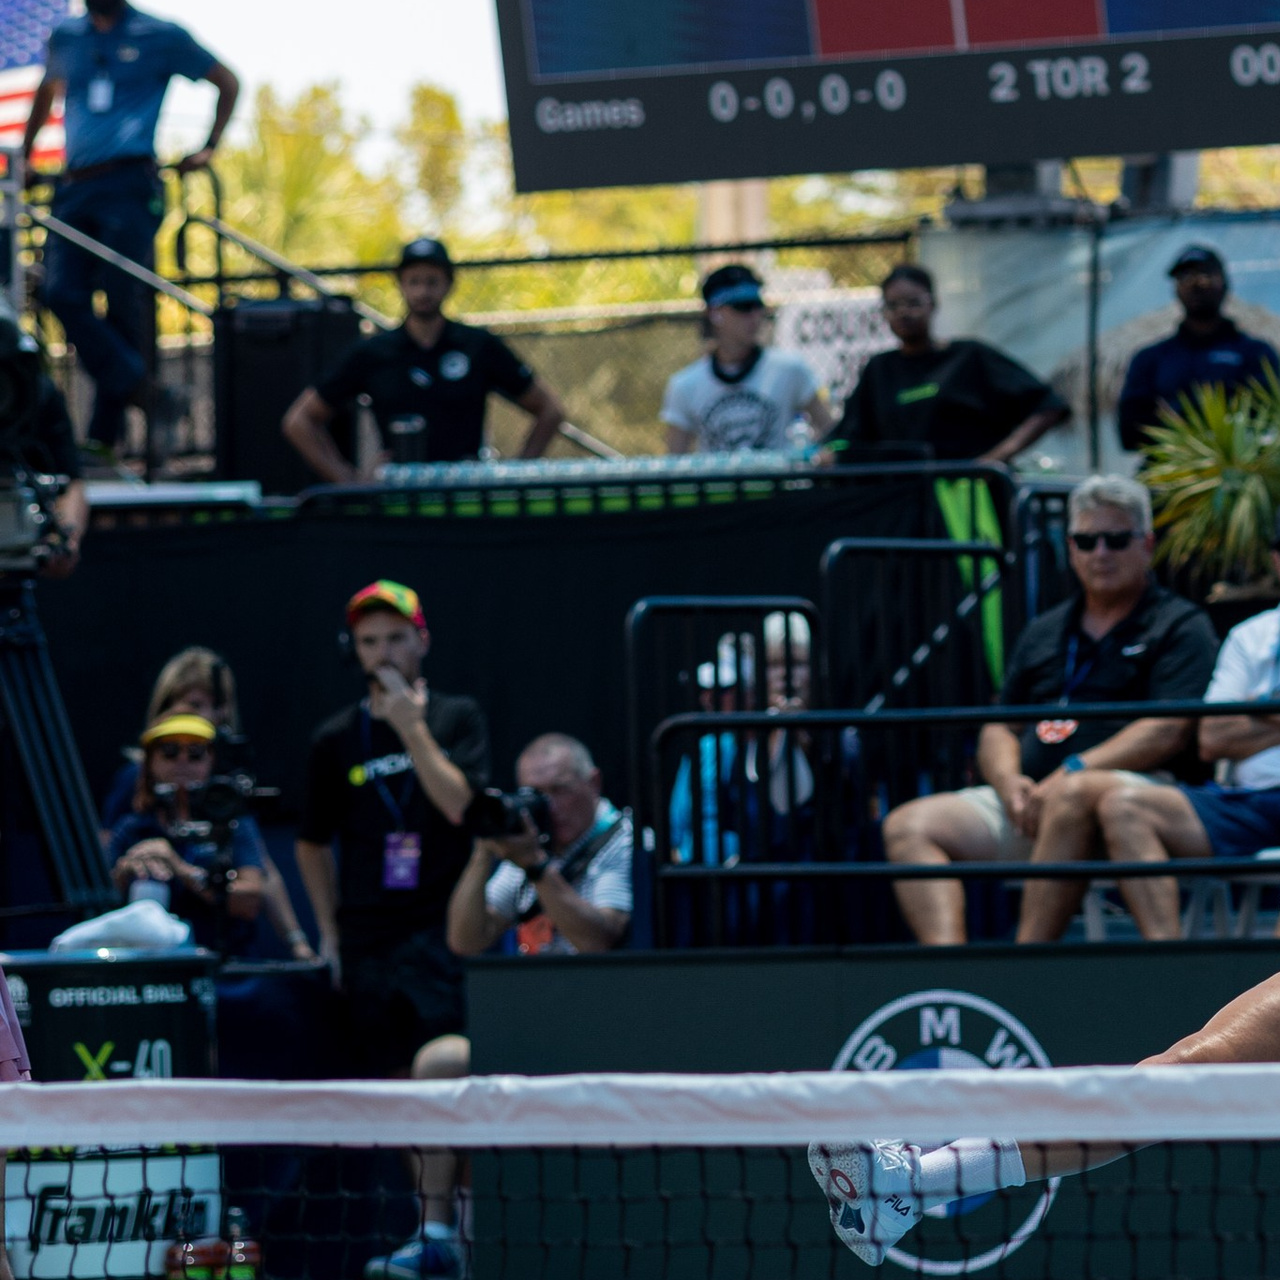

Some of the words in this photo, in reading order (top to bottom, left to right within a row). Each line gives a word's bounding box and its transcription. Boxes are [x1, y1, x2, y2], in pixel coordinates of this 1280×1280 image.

[988, 61, 1020, 103] 2
[1026, 55, 1111, 101] TOR
[1121, 51, 1152, 94] 2
[535, 96, 645, 134] Games
[48, 986, 141, 1008] OFFICIAL
[143, 984, 188, 1004] BALL
